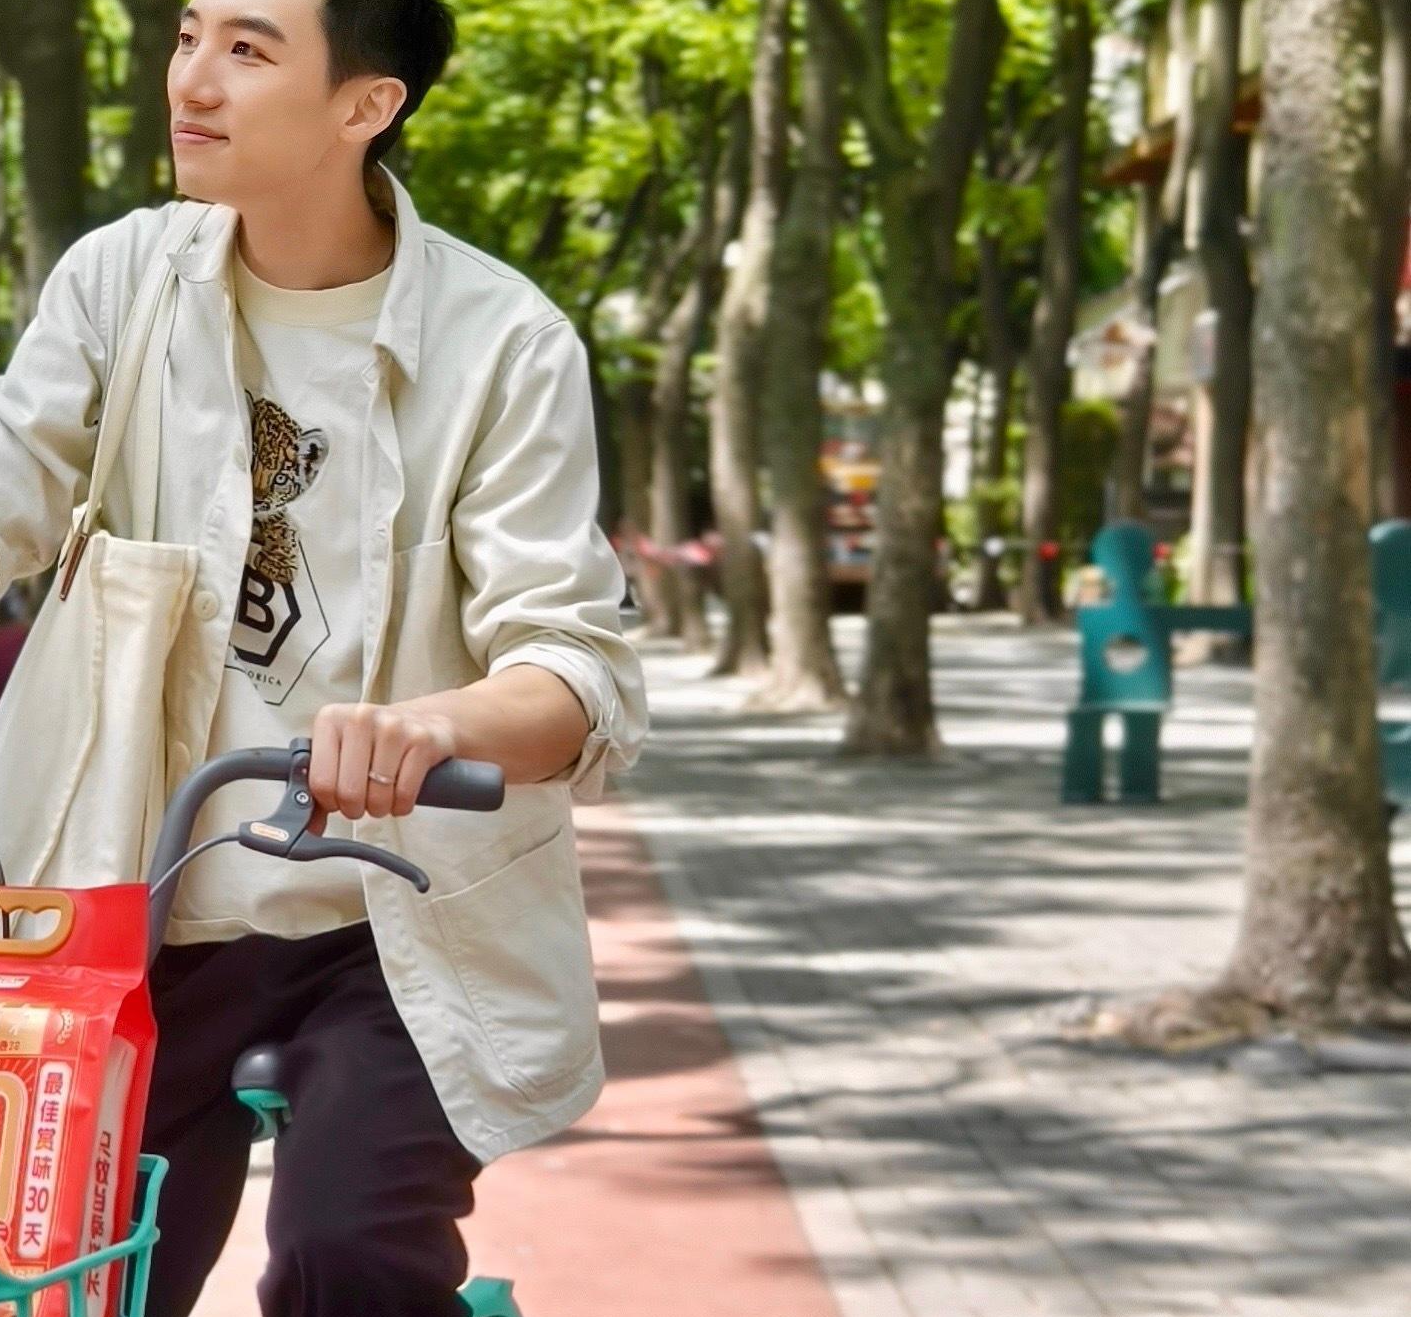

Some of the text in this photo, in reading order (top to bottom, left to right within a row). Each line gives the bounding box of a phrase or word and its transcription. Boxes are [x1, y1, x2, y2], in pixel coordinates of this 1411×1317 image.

[238, 564, 276, 633] B
[23, 1071, 64, 1247] 最佳赏味30天
